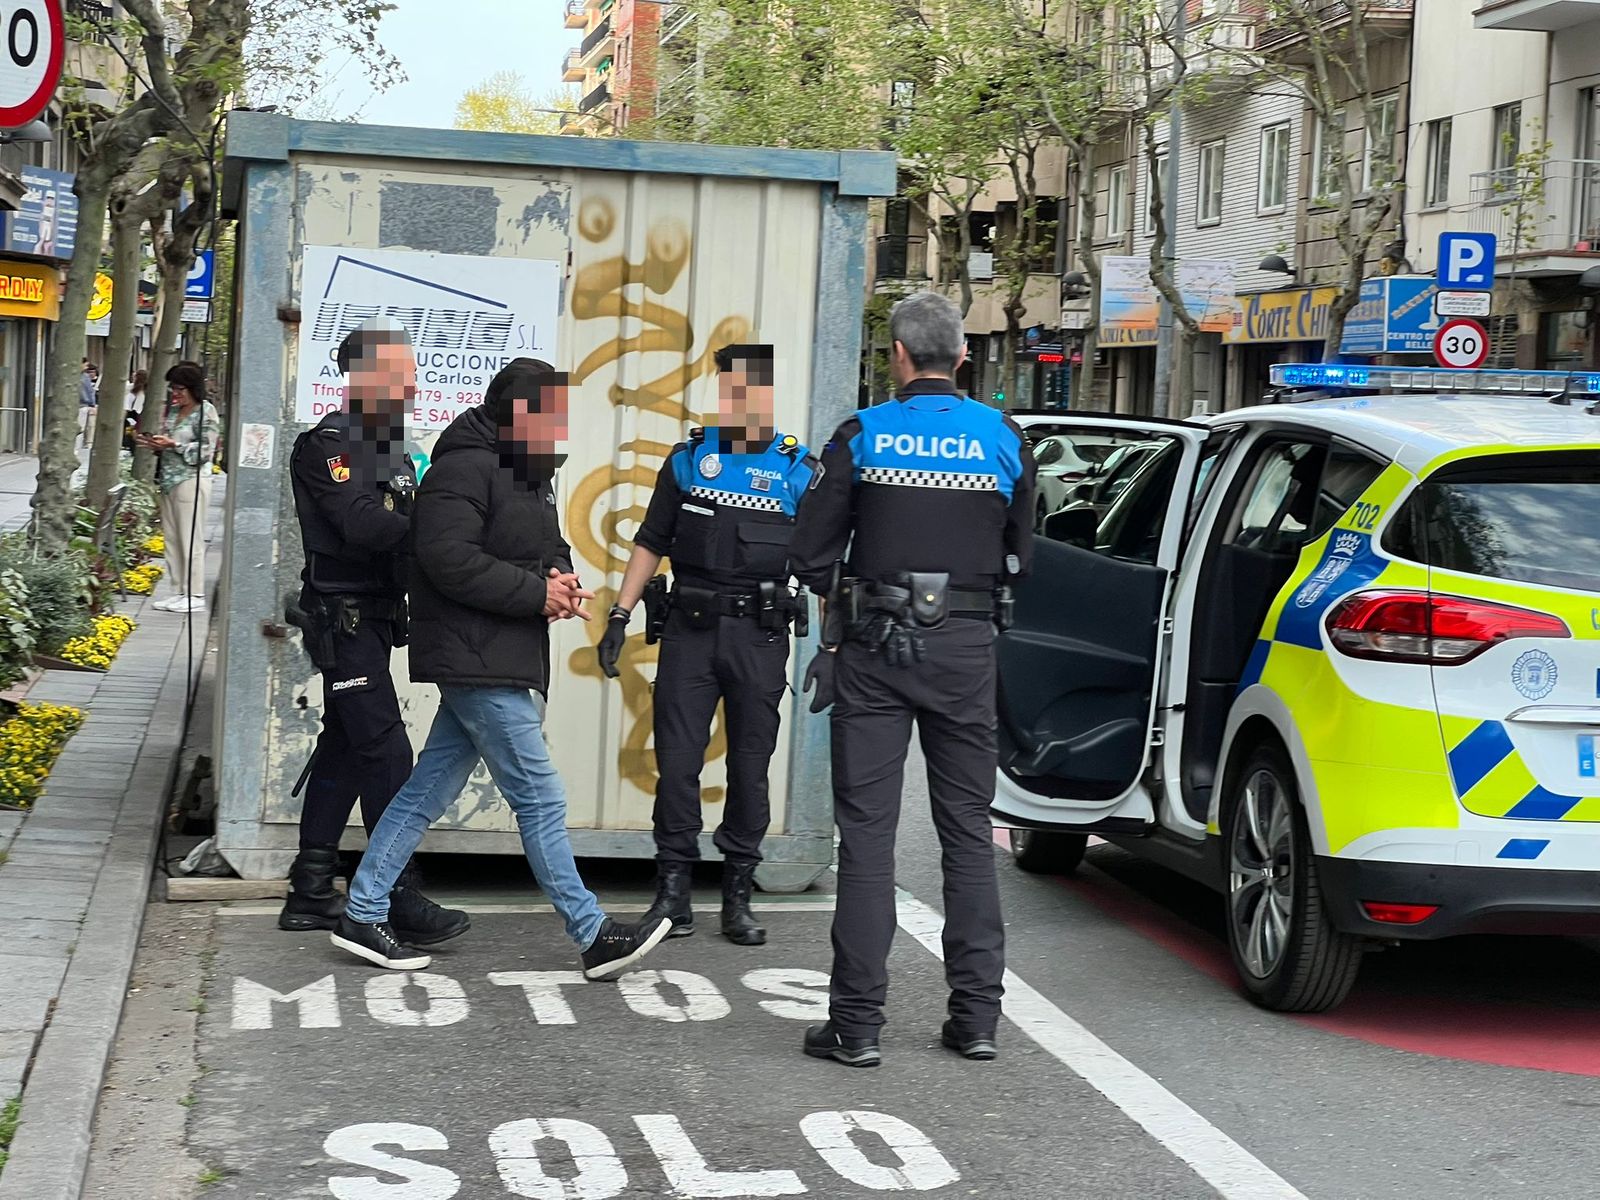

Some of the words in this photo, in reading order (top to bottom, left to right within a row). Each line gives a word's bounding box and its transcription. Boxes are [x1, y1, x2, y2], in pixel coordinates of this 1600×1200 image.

[0, 9, 38, 68] 0
[1447, 239, 1484, 282] P
[1247, 293, 1291, 338] CORTE
[1297, 289, 1328, 337] CHI
[516, 324, 543, 351] S.L.
[1446, 336, 1476, 354] 30
[425, 371, 482, 386] Carlos
[874, 433, 986, 460] POLICÍA
[745, 467, 782, 480] POLICÍA
[1349, 501, 1380, 529] 702
[1582, 760, 1592, 770] E
[230, 968, 831, 1029] MOTOS
[322, 1110, 962, 1200] SOLO
